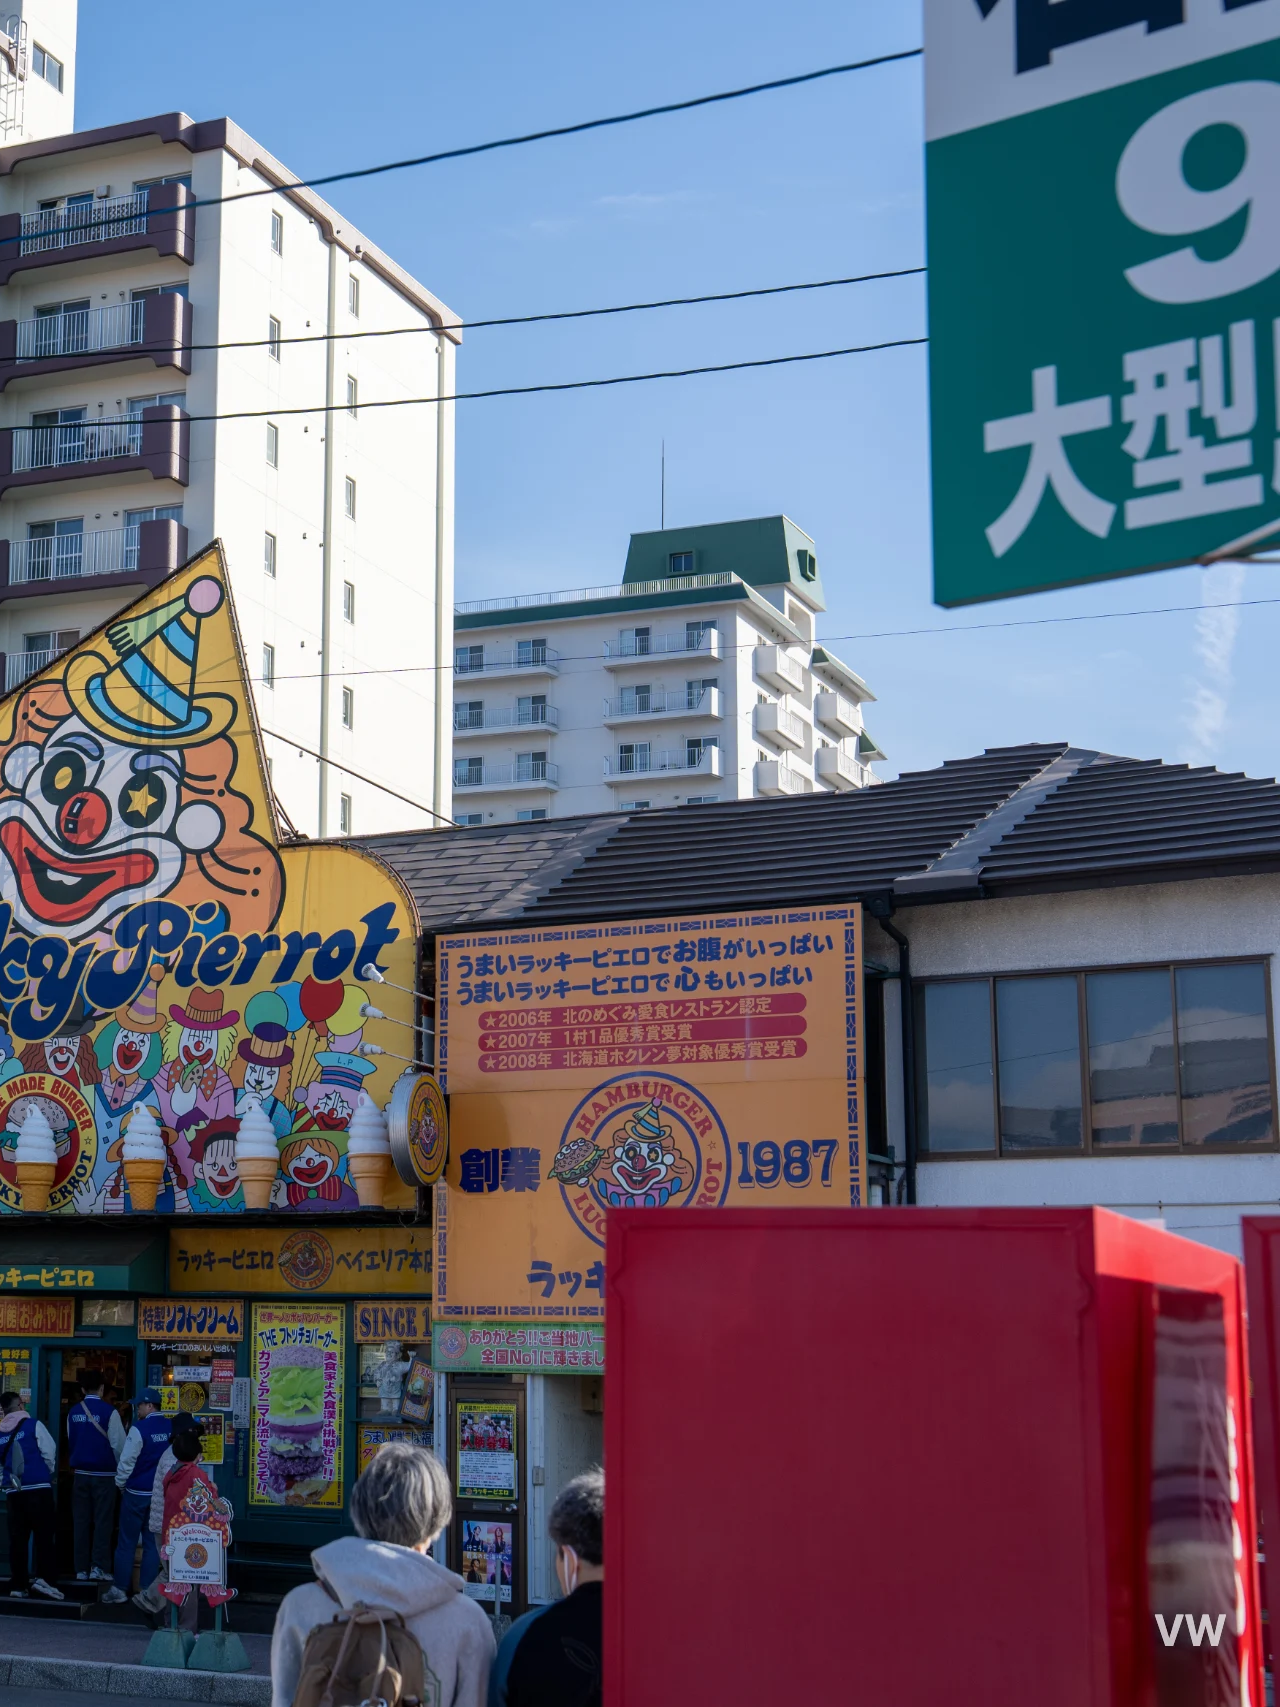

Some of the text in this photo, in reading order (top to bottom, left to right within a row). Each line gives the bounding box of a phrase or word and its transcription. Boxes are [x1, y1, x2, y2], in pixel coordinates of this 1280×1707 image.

[1115, 79, 1280, 305] 9
[983, 317, 1280, 559] 大型
[86, 898, 400, 1011] Pierrot
[456, 932, 834, 977] うまいラッキーピエロでお腹がいっぱい
[456, 965, 813, 1007] うまいラッキーピエロで心もいっぱい
[498, 997, 772, 1027] 2006年 北のめぐみ愛食レストラン認定
[498, 1023, 693, 1049] 2007年 1村1品優秀賞受賞
[498, 1039, 797, 1068] 2008年 北海道ホクレン夢対象優秀賞受賞
[337, 1056, 354, 1066] L.P
[5, 1075, 46, 1099] MADE
[49, 1081, 94, 1132] BURGER
[575, 1081, 713, 1138] HAMBURGER
[46, 1150, 93, 1208] ERROT
[459, 1147, 542, 1194] 創業
[736, 1138, 839, 1190] 1987
[176, 1249, 275, 1272] ラッキーピエロ
[142, 1305, 239, 1335] 特製ソフトクリーム
[258, 1326, 338, 1349] THE フトッチョバーガー
[359, 1306, 418, 1338] SINCE
[180, 1527, 212, 1538] Welcome
